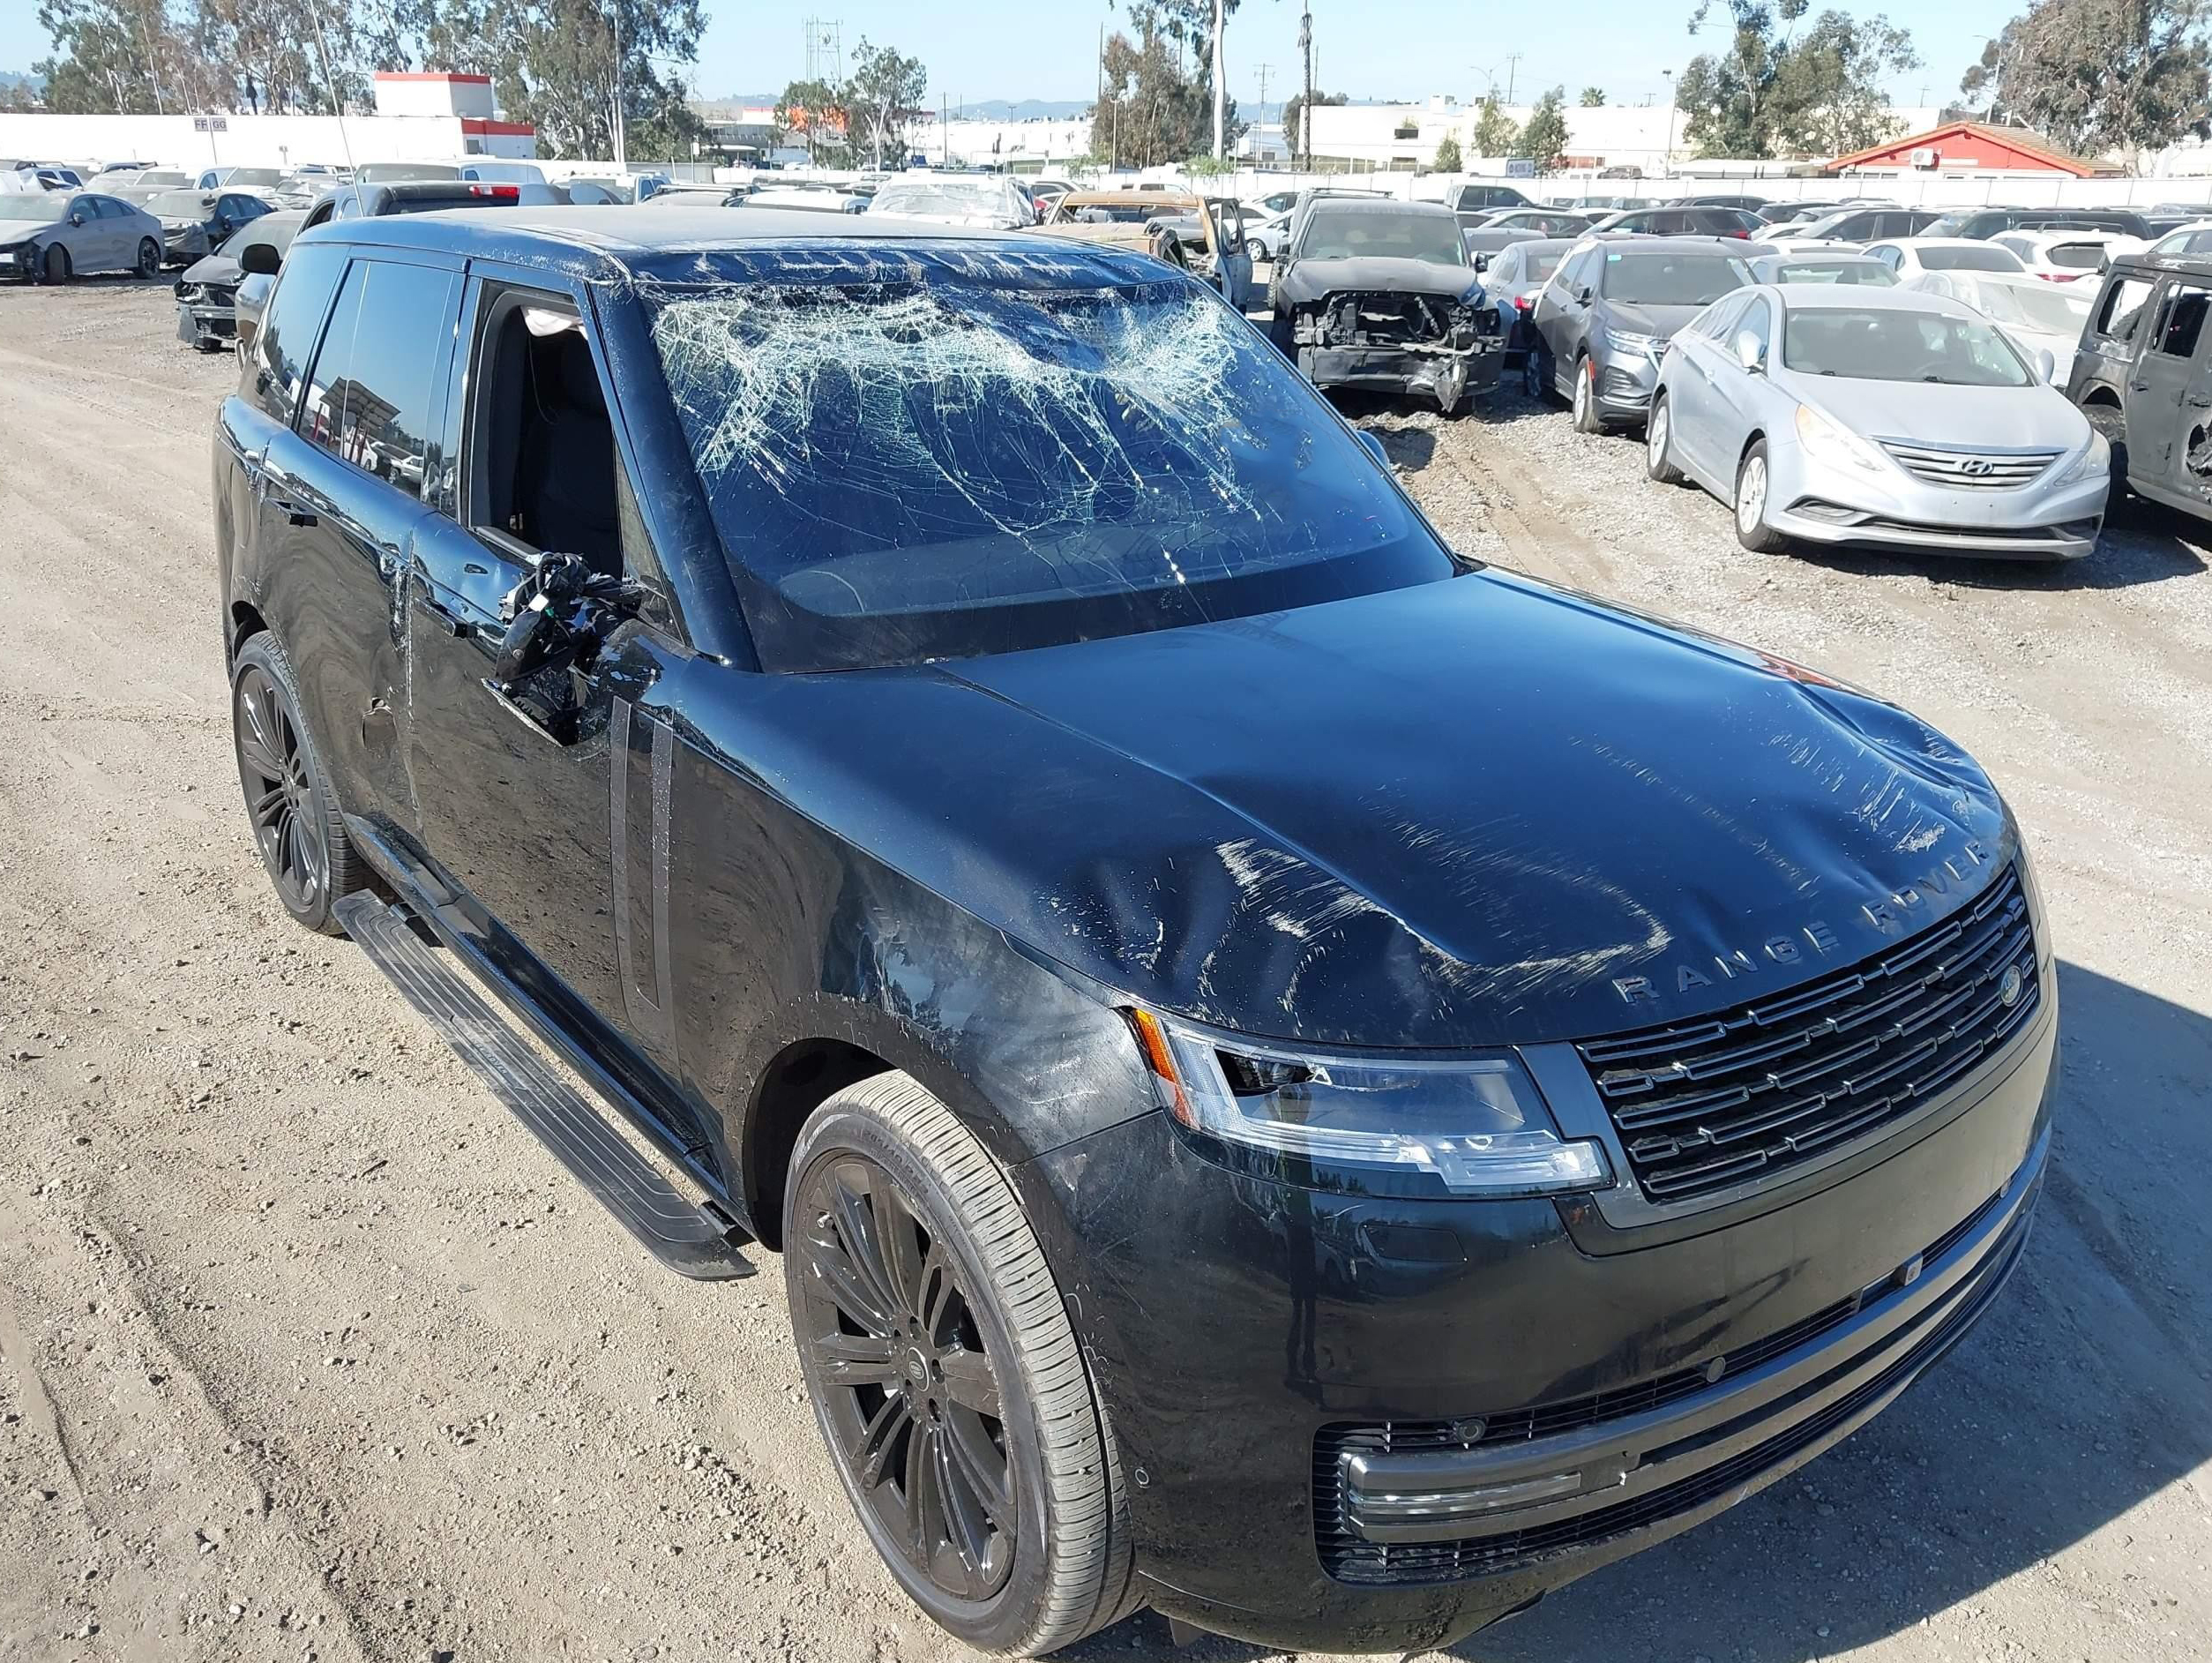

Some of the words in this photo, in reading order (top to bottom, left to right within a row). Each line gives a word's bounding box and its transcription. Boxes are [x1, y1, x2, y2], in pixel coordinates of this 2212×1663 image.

[194, 119, 207, 129] FF
[213, 120, 227, 129] GG
[1612, 920, 1841, 1003] RANGE
[1862, 841, 1991, 927] ROVER
